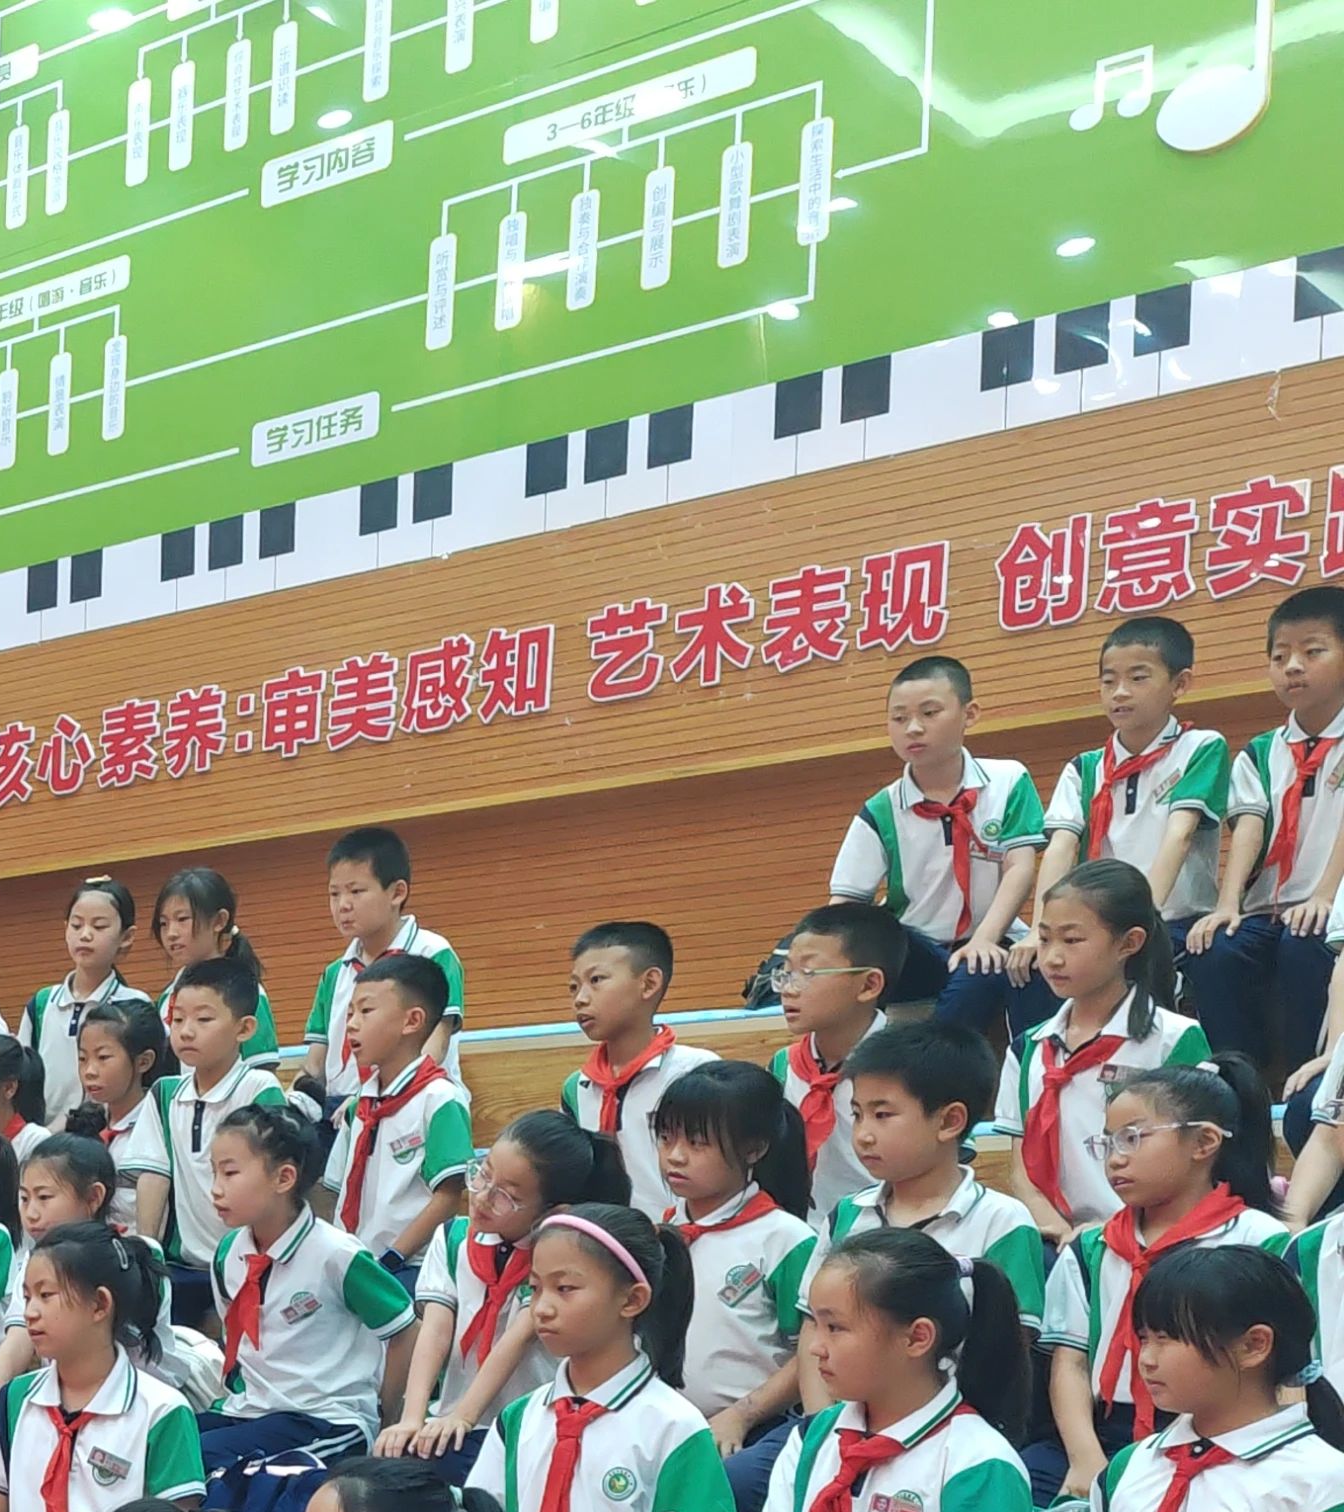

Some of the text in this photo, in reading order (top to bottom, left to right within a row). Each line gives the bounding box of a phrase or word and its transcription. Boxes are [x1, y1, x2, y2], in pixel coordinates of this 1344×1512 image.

[277, 136, 376, 193] 学习内容
[648, 184, 668, 269] 创编与展示
[266, 406, 364, 454] 学习任务
[586, 540, 951, 703] 艺术表现
